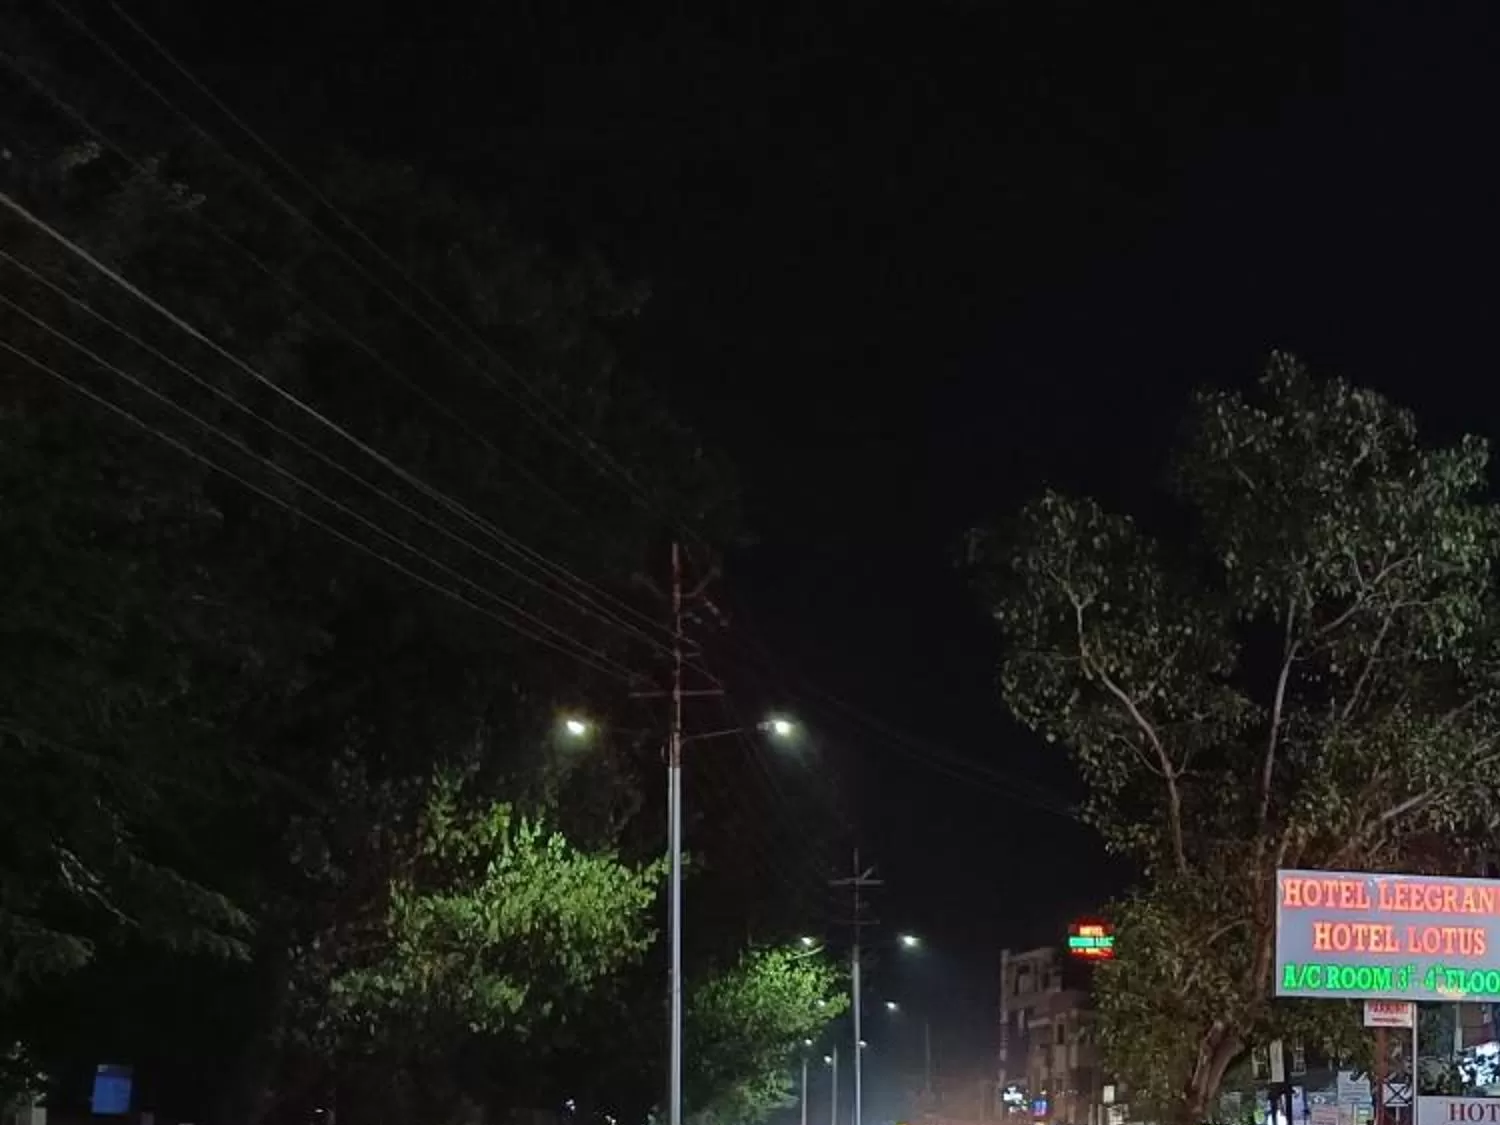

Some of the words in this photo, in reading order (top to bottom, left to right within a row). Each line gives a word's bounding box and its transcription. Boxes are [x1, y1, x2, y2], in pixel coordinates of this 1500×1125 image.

[1283, 877, 1371, 909] HOTEL
[1313, 921, 1400, 953] HOTEL
[1406, 926, 1487, 957] LOTUS
[1283, 963, 1322, 990] A/C
[1325, 964, 1394, 992] ROOM
